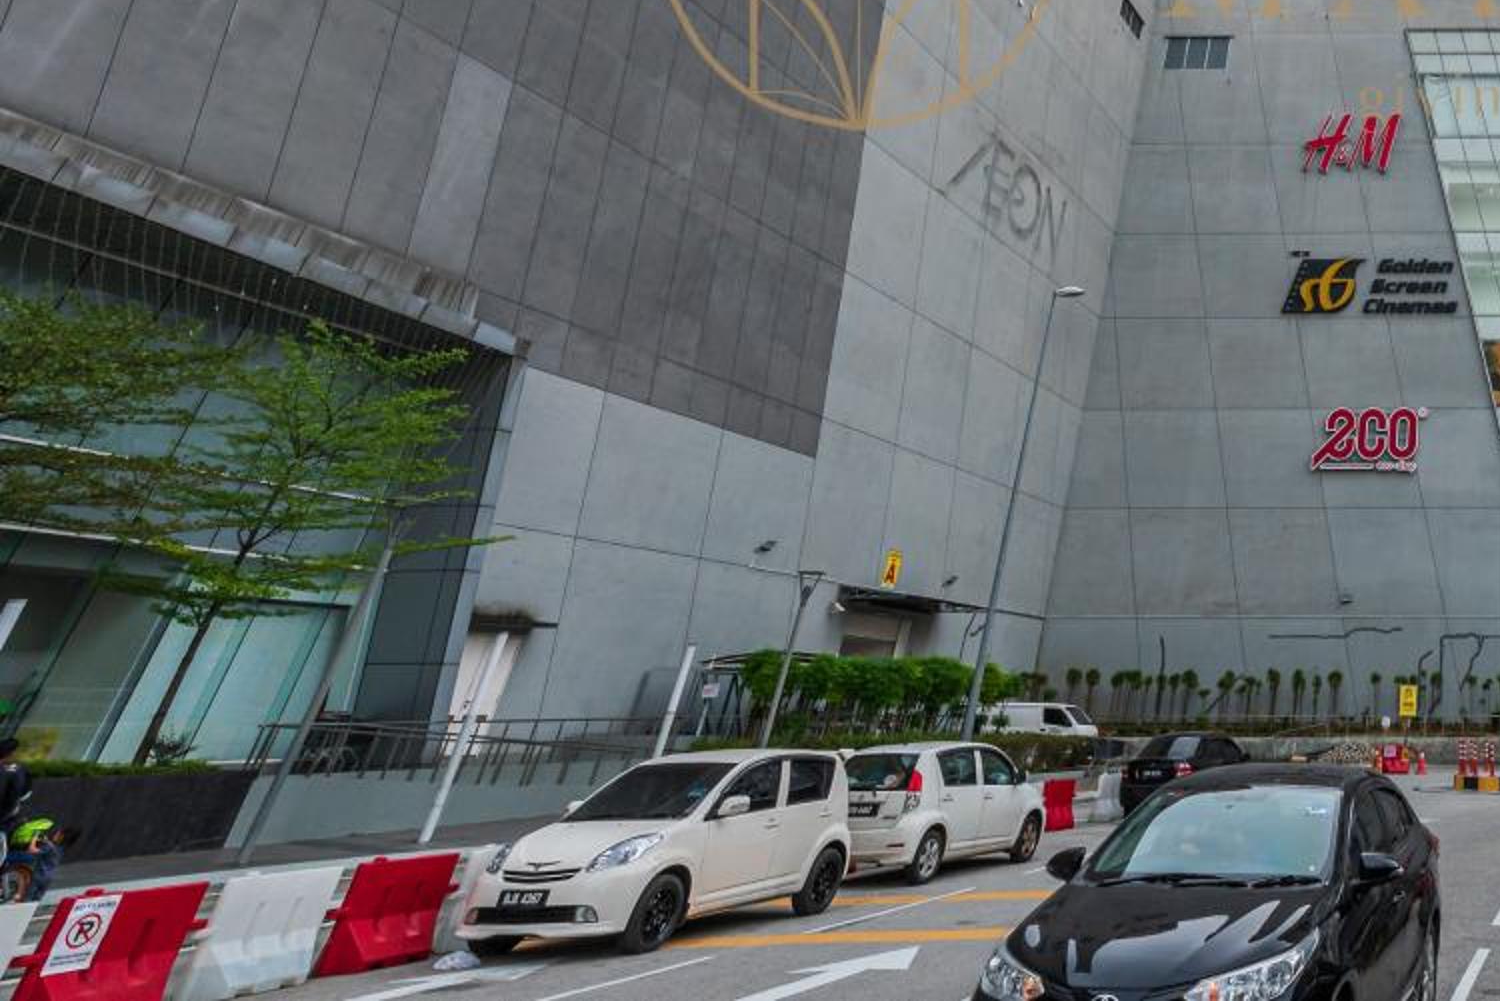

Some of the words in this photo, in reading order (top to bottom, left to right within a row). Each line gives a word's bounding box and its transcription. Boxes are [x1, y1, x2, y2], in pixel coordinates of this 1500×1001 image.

[1302, 112, 1401, 175] H&M
[1376, 258, 1454, 274] Golden
[1370, 278, 1448, 294] Screen
[1363, 298, 1458, 314] Cinemas
